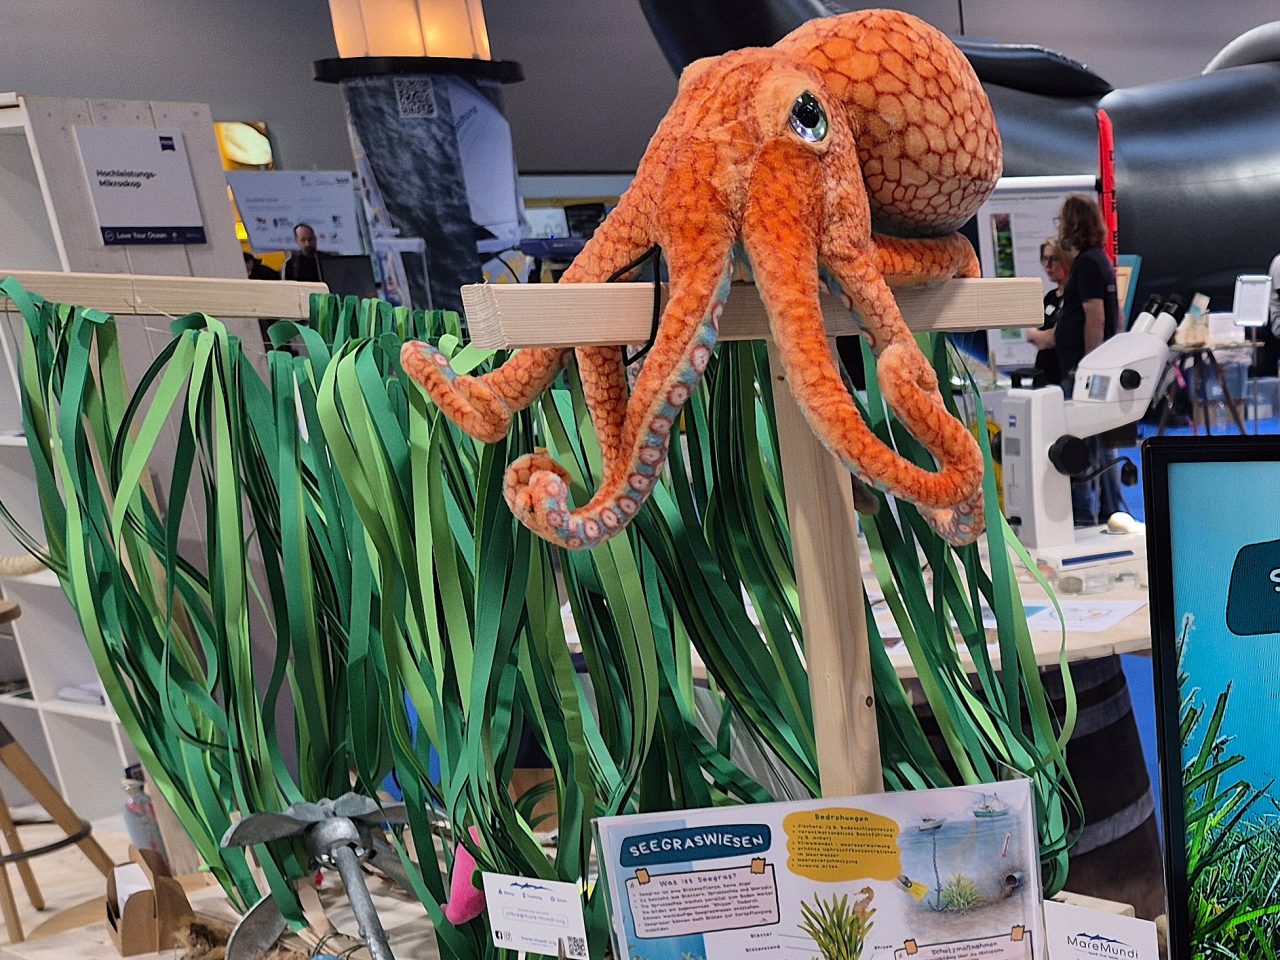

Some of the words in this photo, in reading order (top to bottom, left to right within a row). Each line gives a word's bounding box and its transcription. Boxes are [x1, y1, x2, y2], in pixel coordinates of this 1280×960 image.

[814, 813, 869, 822] Bedrohungen
[629, 833, 764, 857] SEEGRASWIESEN
[698, 873, 737, 883] Seegras?
[931, 941, 998, 956] Schutzmaßnahmen
[1067, 935, 1138, 959] MareMundi
